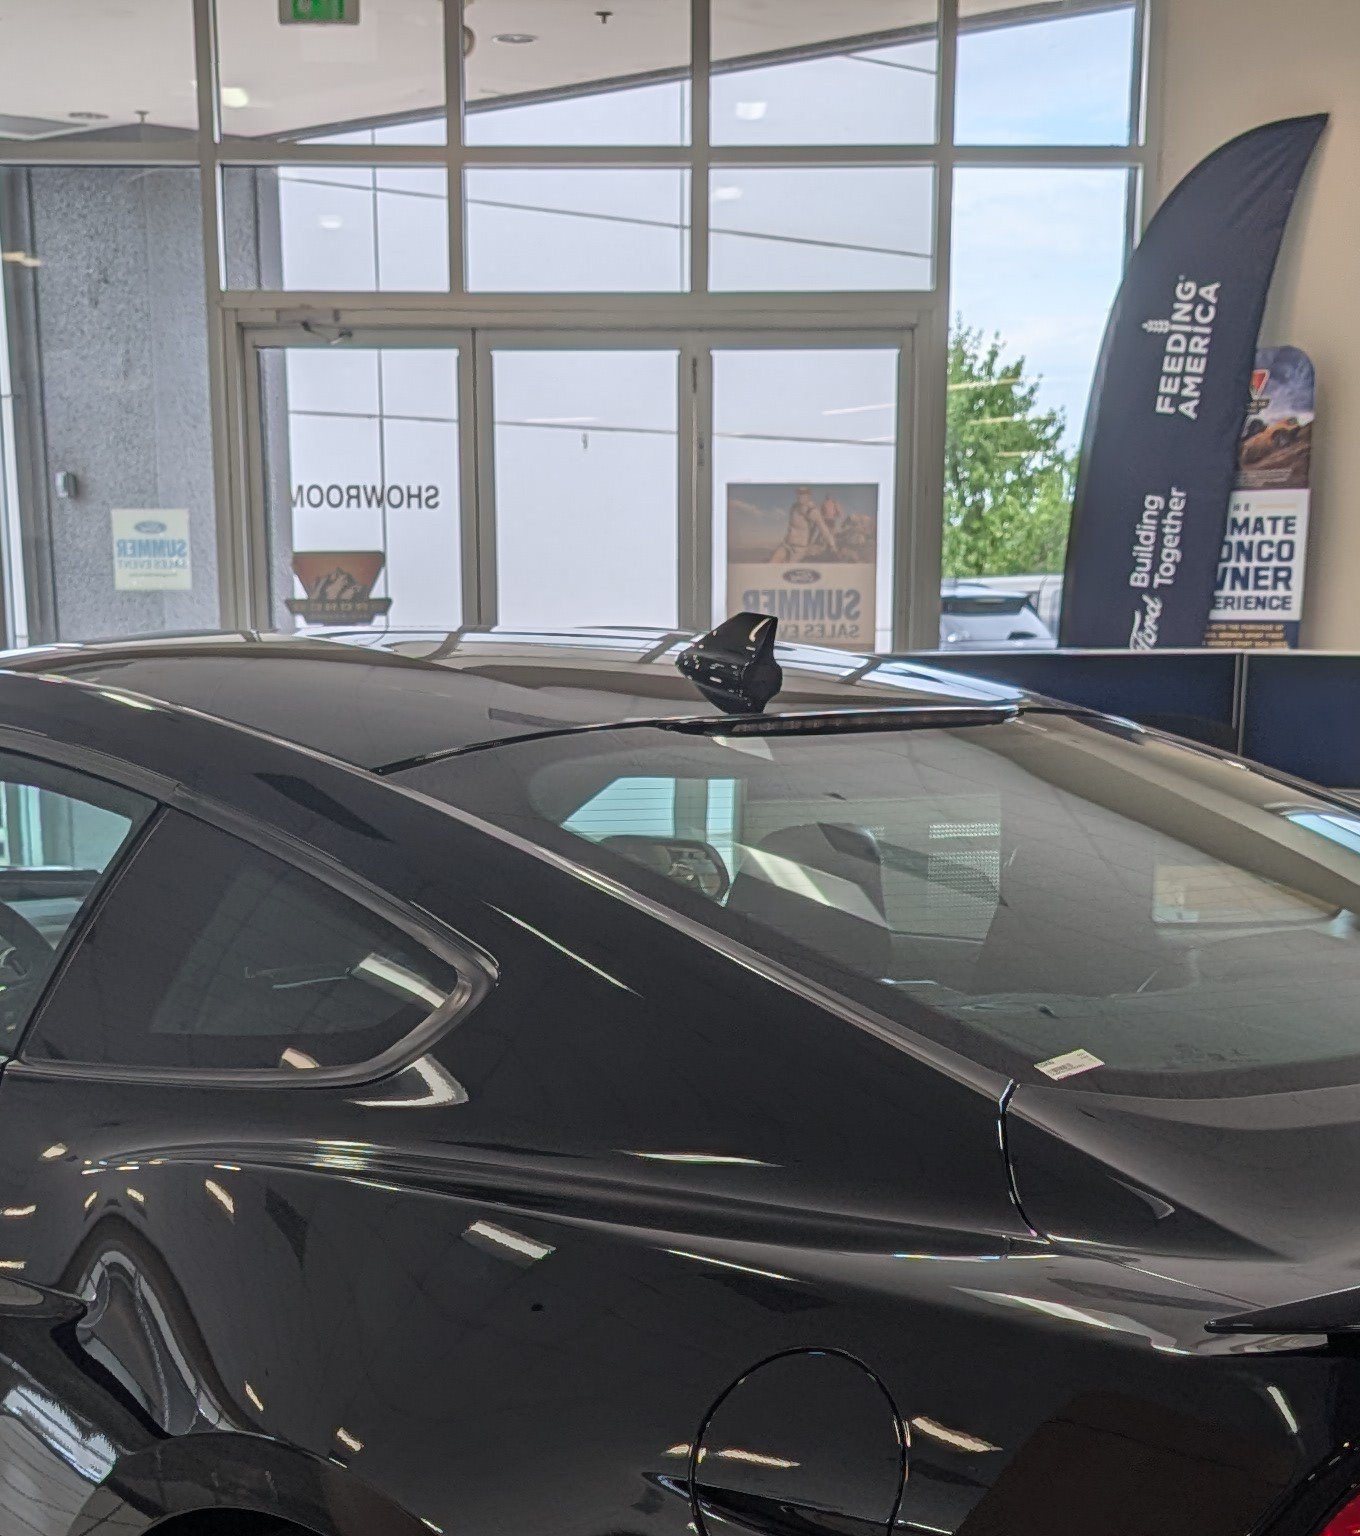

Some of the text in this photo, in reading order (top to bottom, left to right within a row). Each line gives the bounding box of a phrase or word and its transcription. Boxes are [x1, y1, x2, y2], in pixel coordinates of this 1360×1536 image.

[1156, 279, 1199, 415] FEEDING
[1178, 281, 1221, 420] AMERICA
[1129, 494, 1165, 588] Building
[1153, 486, 1187, 588] Together
[1219, 539, 1295, 563] ONCO
[1230, 516, 1297, 536] MATE
[1213, 595, 1292, 611] ERIENCE
[1216, 566, 1293, 591] NER
